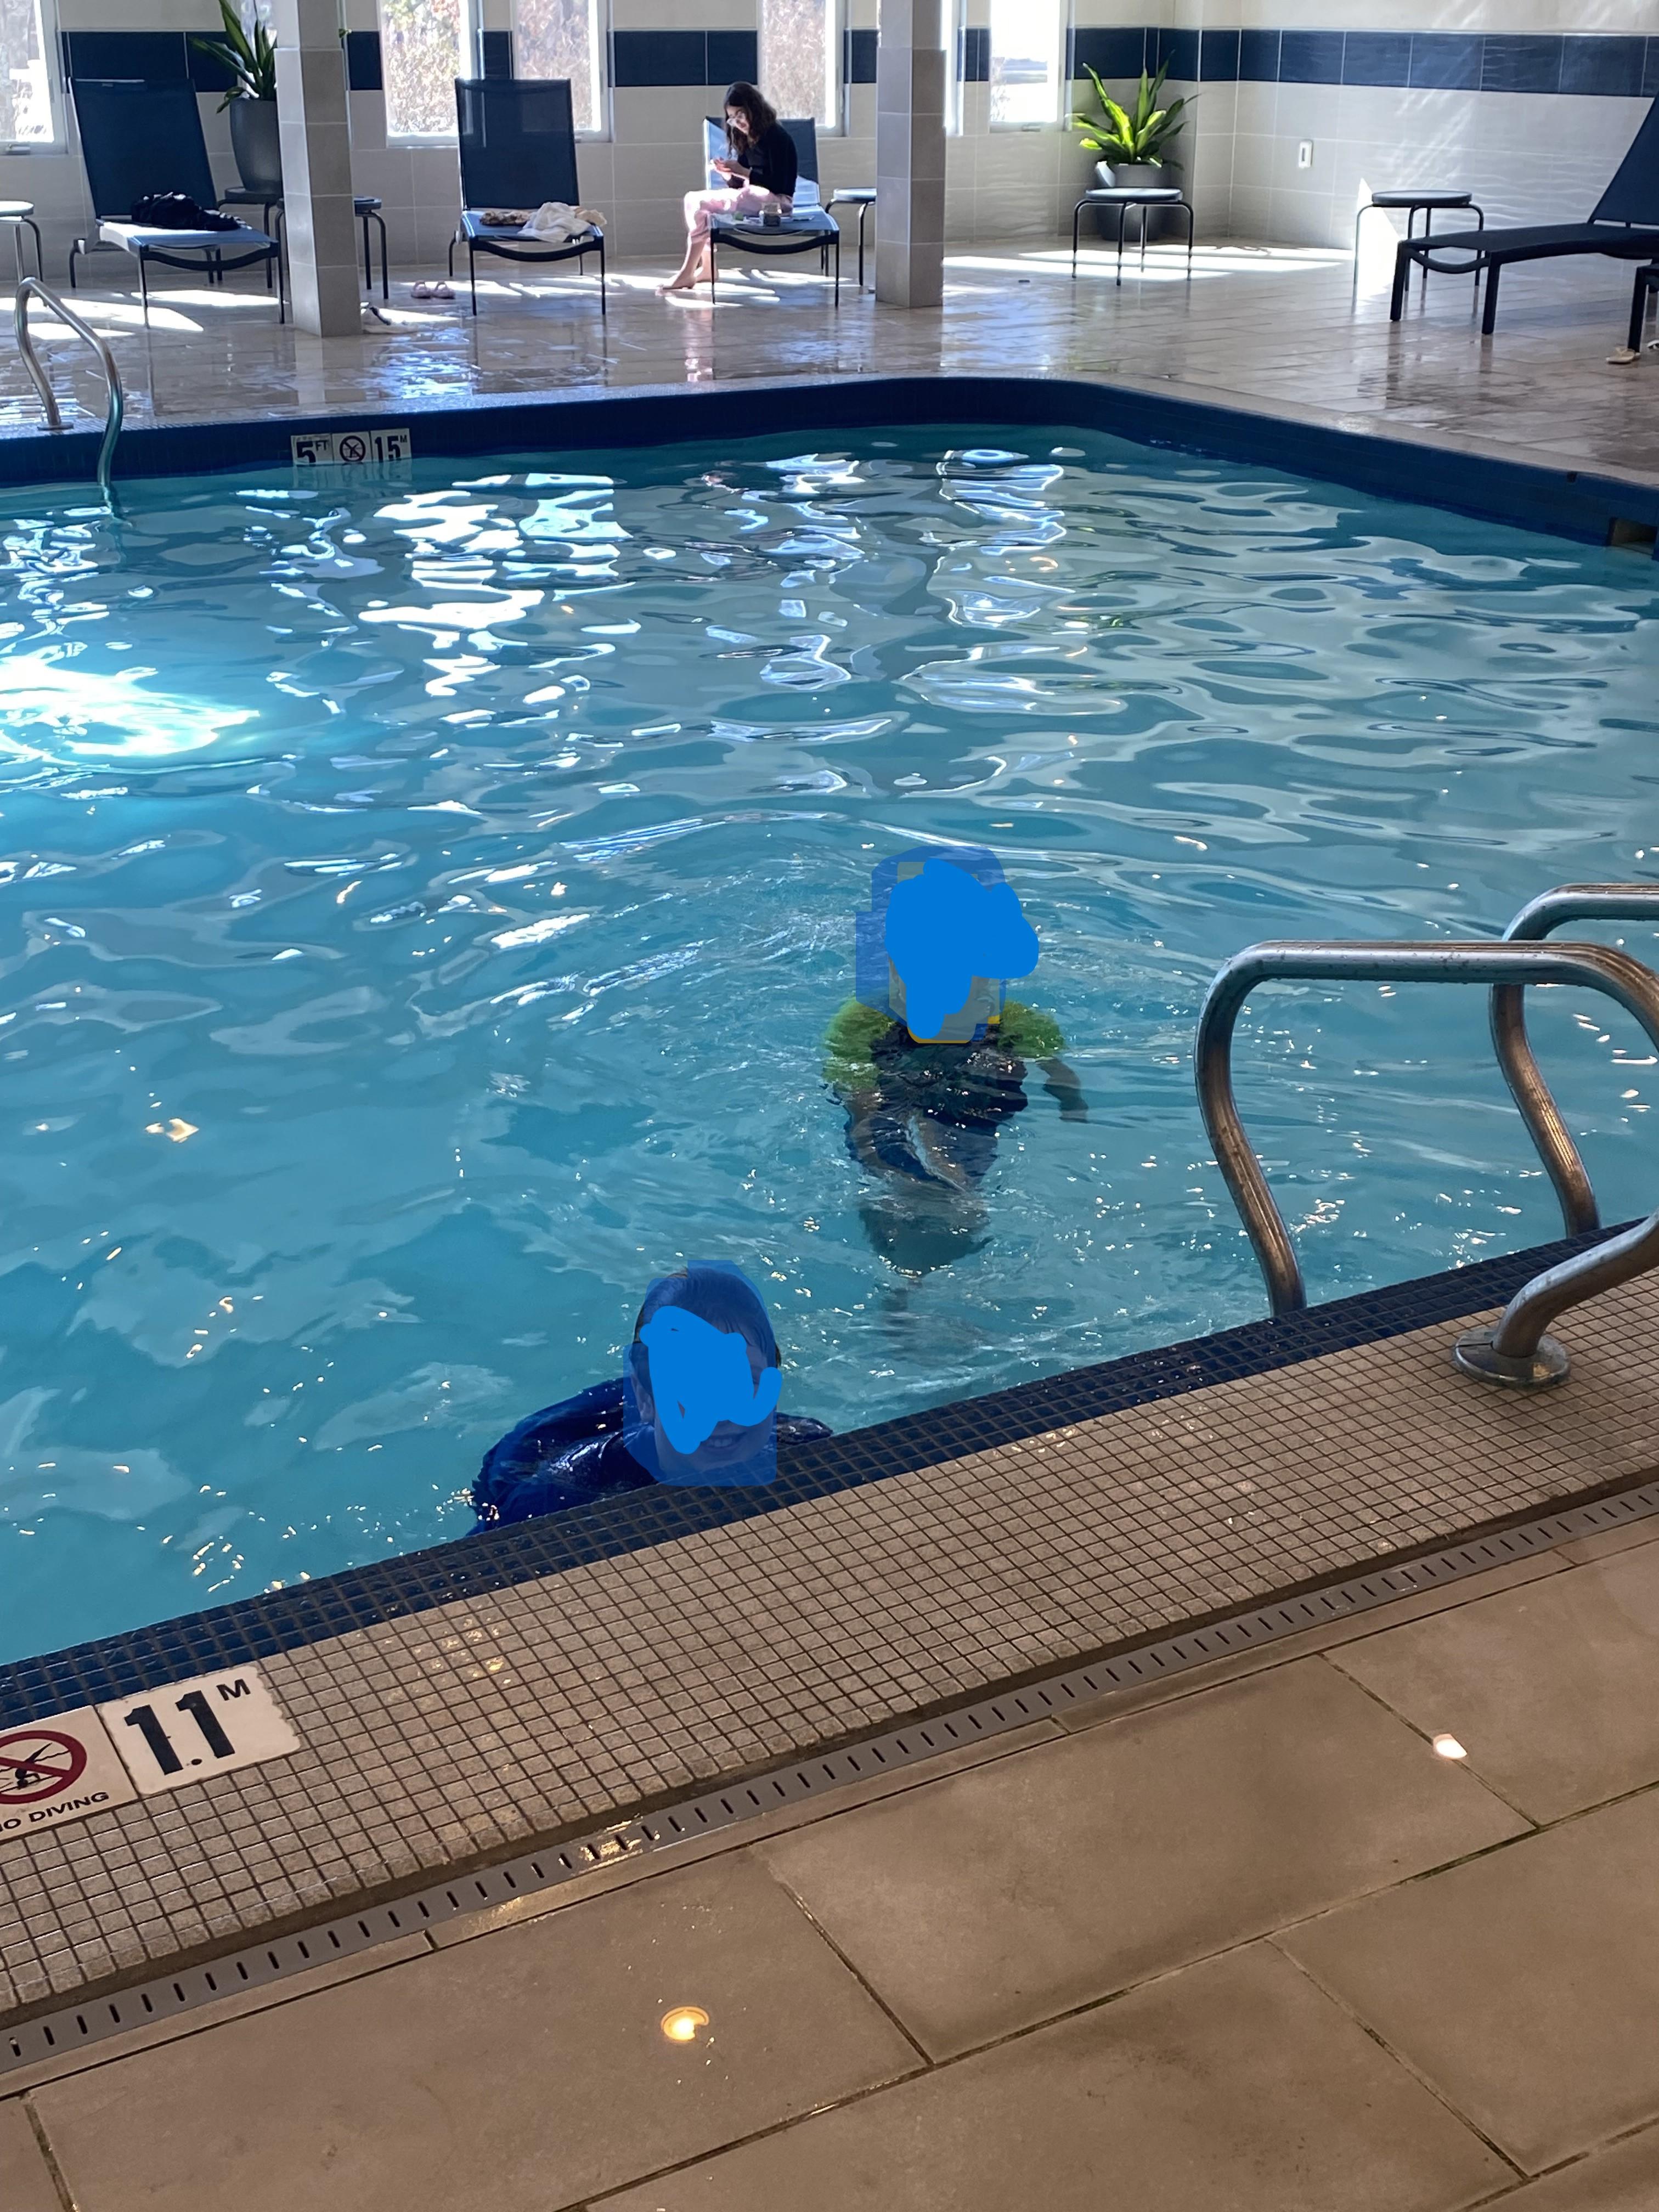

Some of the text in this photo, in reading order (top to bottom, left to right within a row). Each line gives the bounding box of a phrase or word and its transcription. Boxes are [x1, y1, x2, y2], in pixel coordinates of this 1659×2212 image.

[315, 440, 328, 451] FT
[124, 1678, 251, 1775] 1.1 M
[29, 1791, 109, 1822] DIVING
